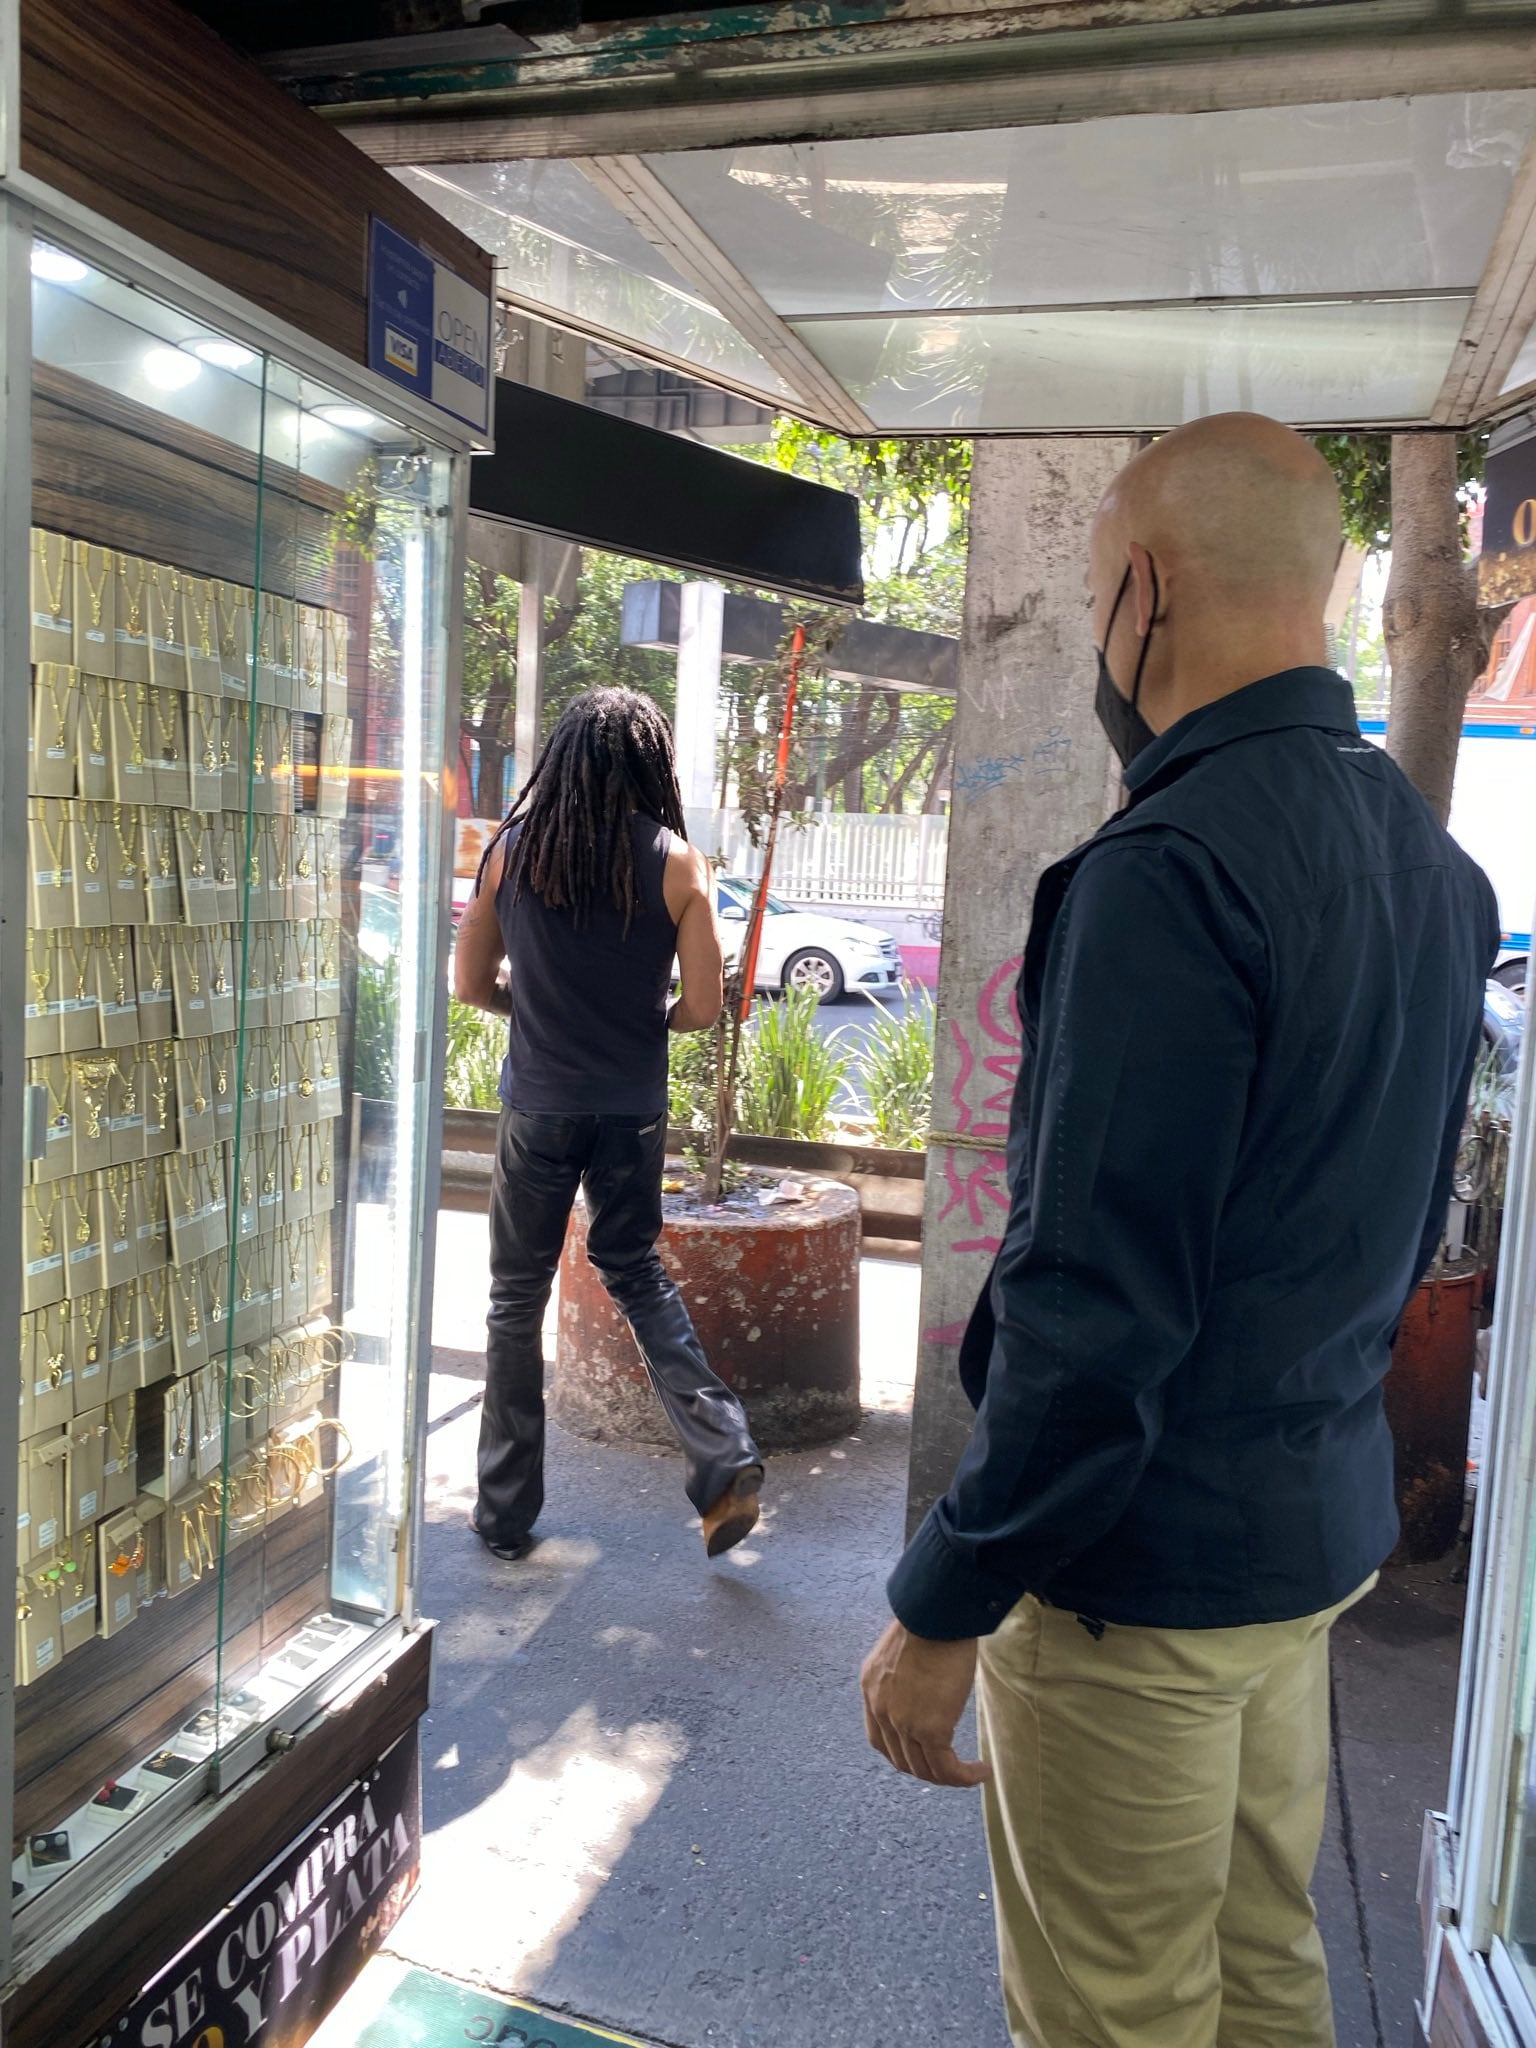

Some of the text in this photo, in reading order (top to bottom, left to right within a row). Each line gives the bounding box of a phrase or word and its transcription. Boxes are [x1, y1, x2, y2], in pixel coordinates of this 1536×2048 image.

[390, 335, 413, 363] VISA
[438, 310, 485, 364] OPEN
[141, 1796, 379, 2048] SE COMPRA
[232, 1812, 411, 2043] Y PLATA
